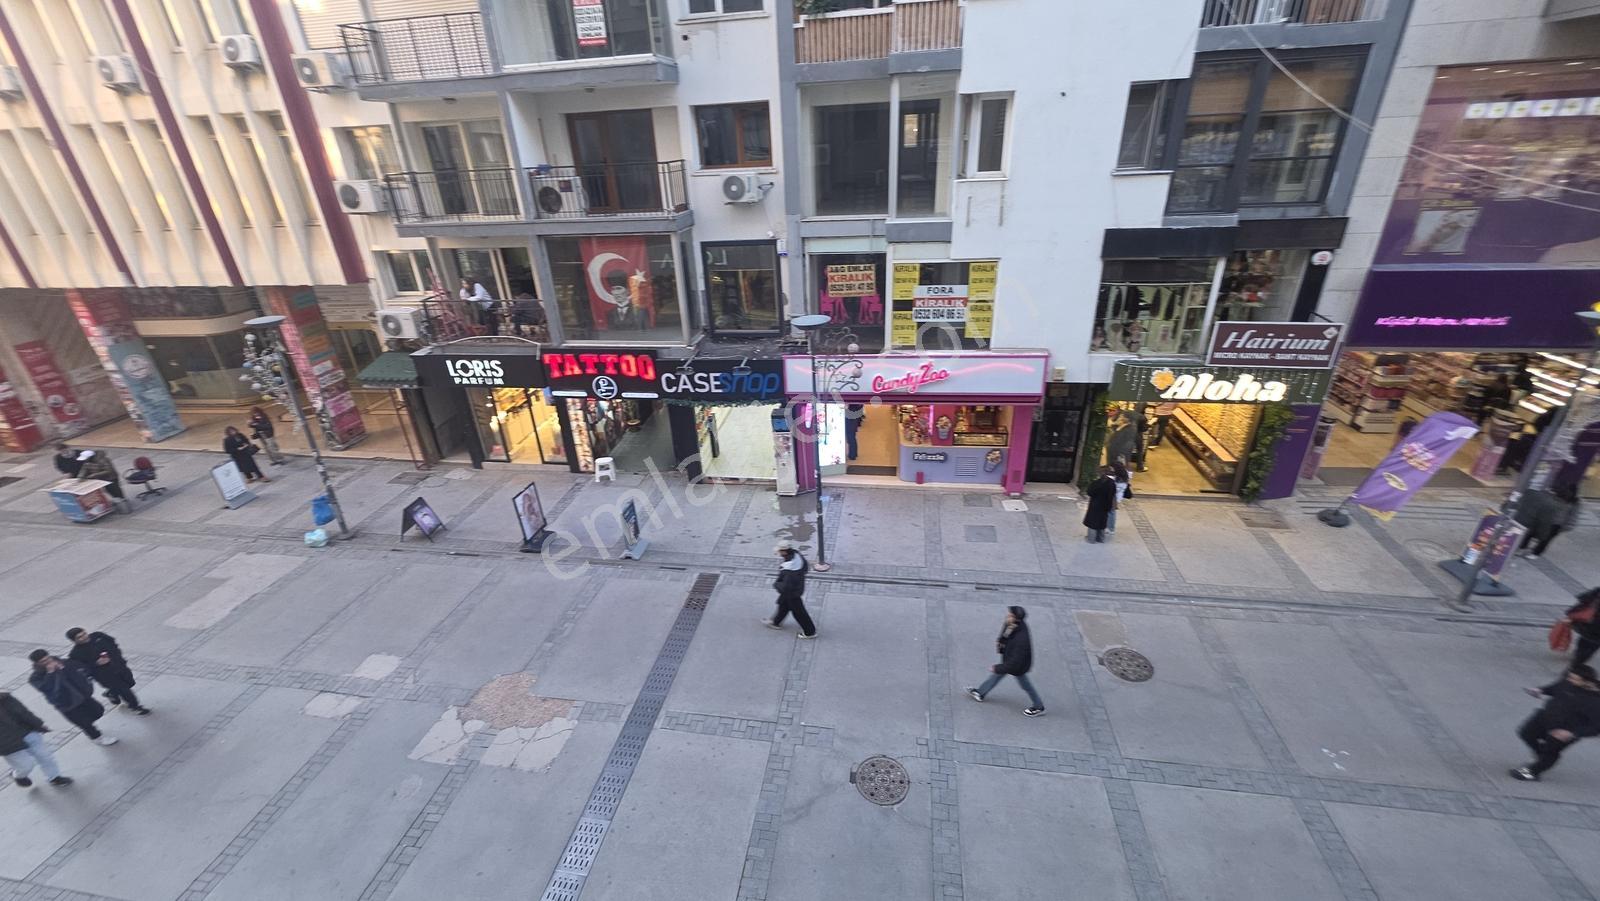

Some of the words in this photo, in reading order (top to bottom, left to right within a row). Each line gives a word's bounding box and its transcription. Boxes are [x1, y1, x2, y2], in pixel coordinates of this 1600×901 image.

[926, 286, 954, 294] FORA
[914, 308, 931, 319] 0532
[1222, 329, 1331, 351] Hairium
[445, 359, 505, 378] LORIS
[542, 353, 657, 381] TATTOO
[453, 377, 505, 385] PARFUM
[1159, 372, 1287, 402] Aloha
